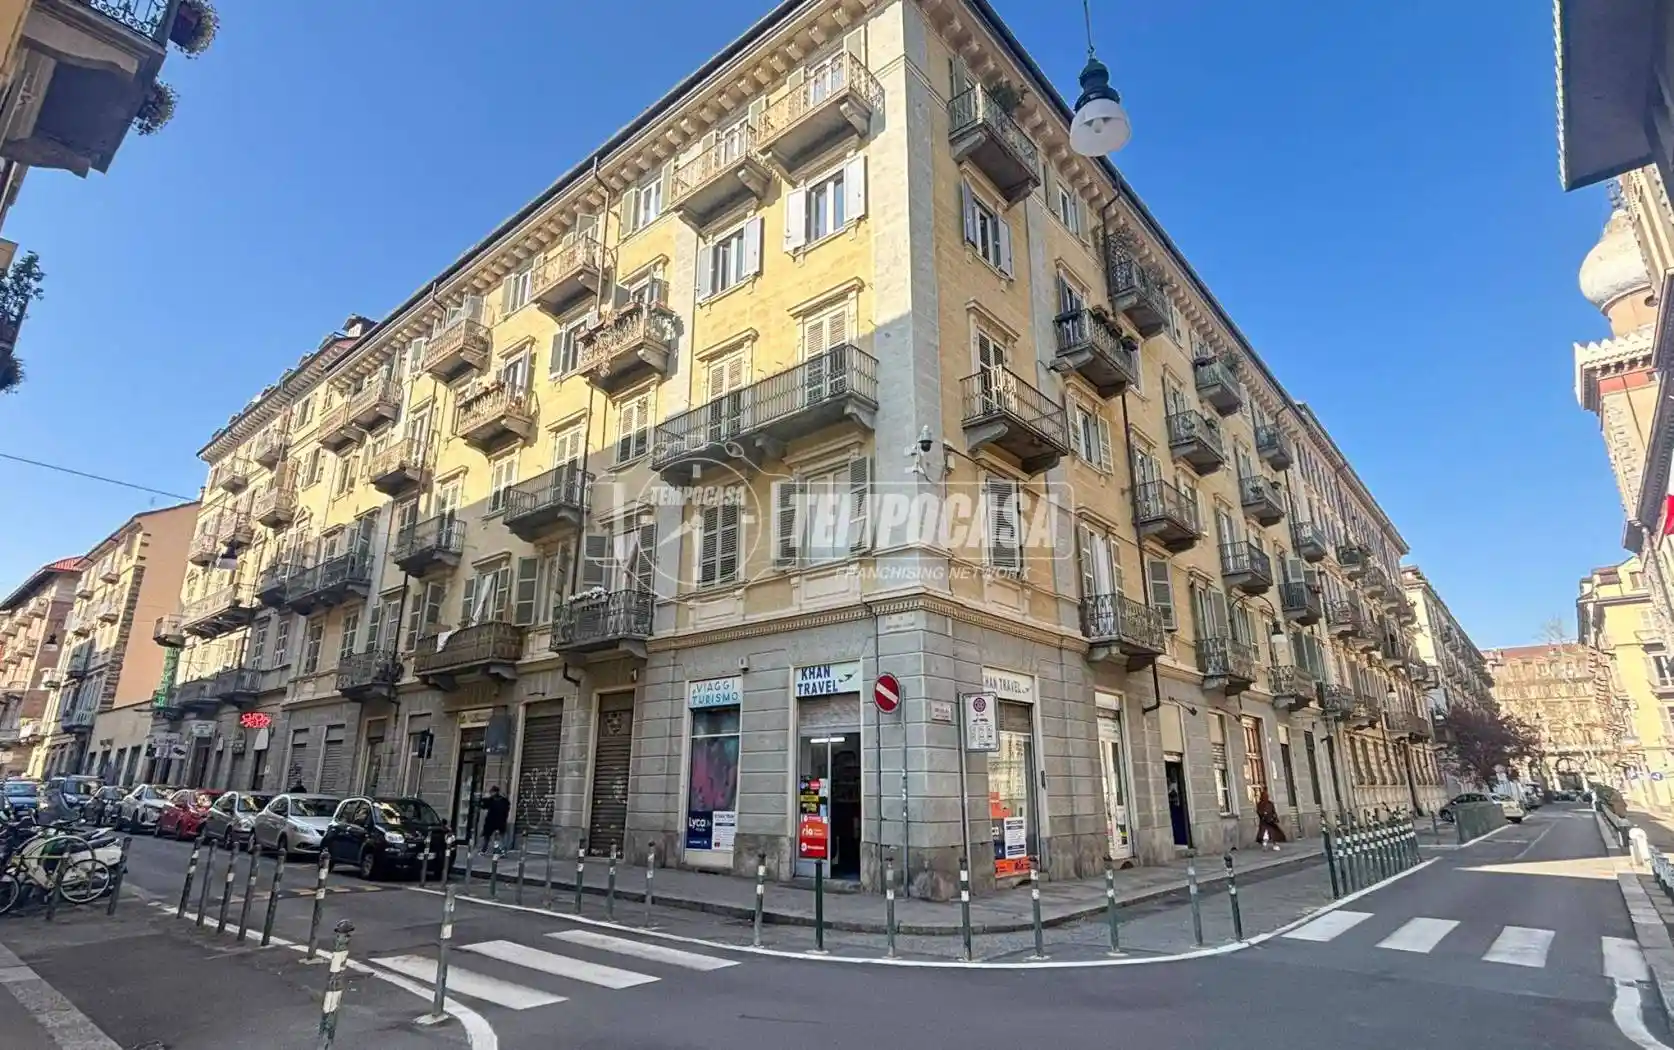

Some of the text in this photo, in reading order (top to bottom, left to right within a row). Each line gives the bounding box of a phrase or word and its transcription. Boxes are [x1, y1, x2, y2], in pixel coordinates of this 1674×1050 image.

[801, 664, 831, 681] KHAN
[696, 679, 735, 692] VIAGGI
[797, 680, 838, 696] TRAVEL
[999, 678, 1020, 693] TRAVEL
[692, 691, 738, 705] TURISMO
